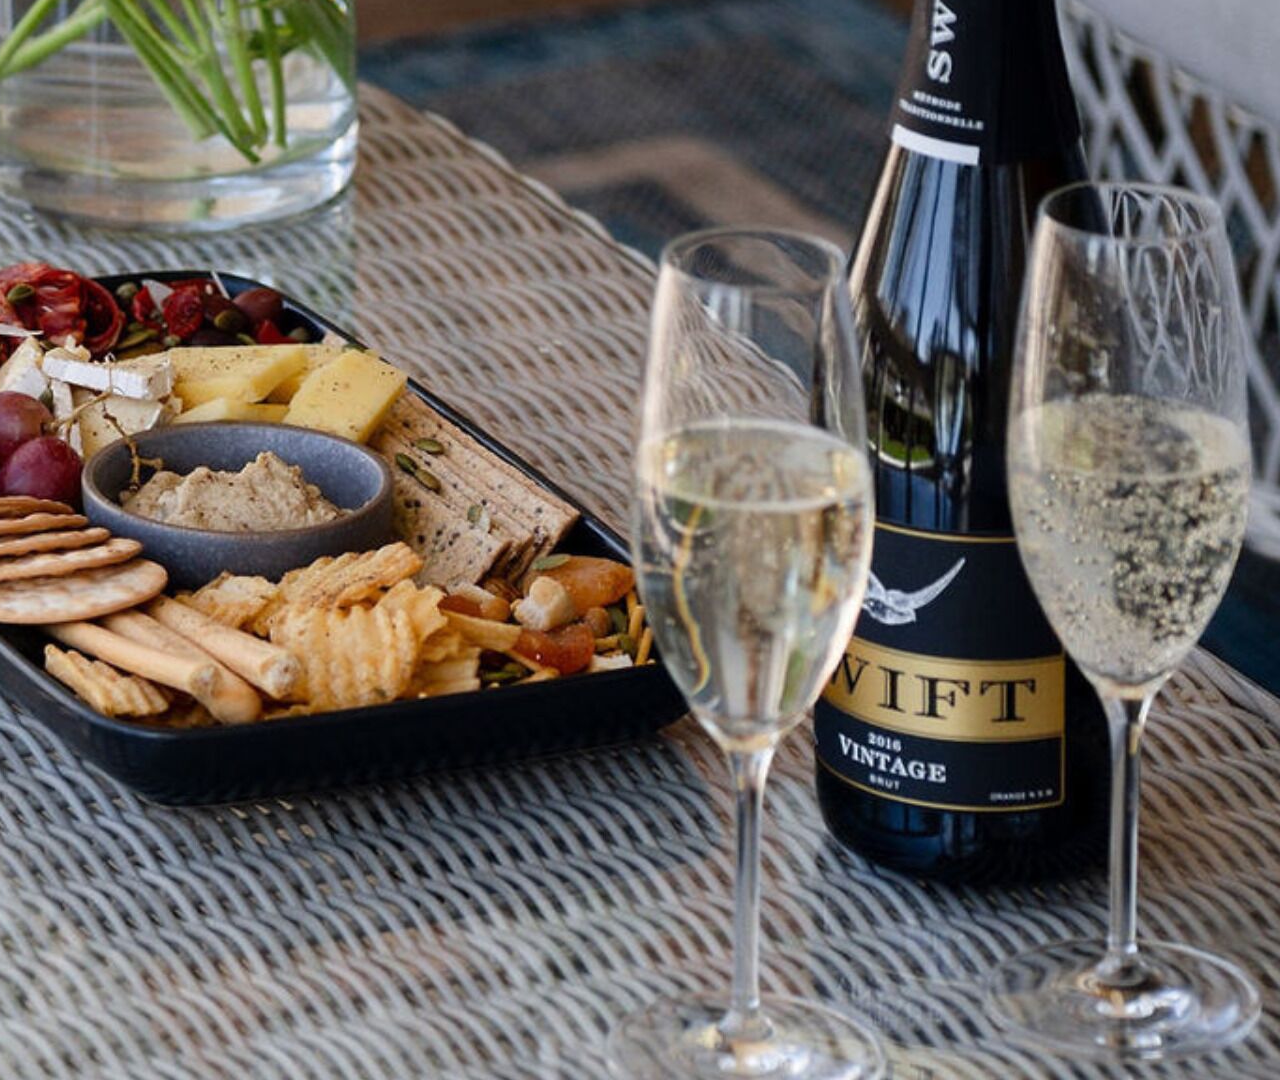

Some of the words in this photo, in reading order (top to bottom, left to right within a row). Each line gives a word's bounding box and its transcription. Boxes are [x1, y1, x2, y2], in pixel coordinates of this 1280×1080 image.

[831, 652, 1037, 723] WIFT
[837, 732, 947, 784] VINTAGE
[868, 732, 902, 753] 2016
[869, 773, 901, 791] BRUT
